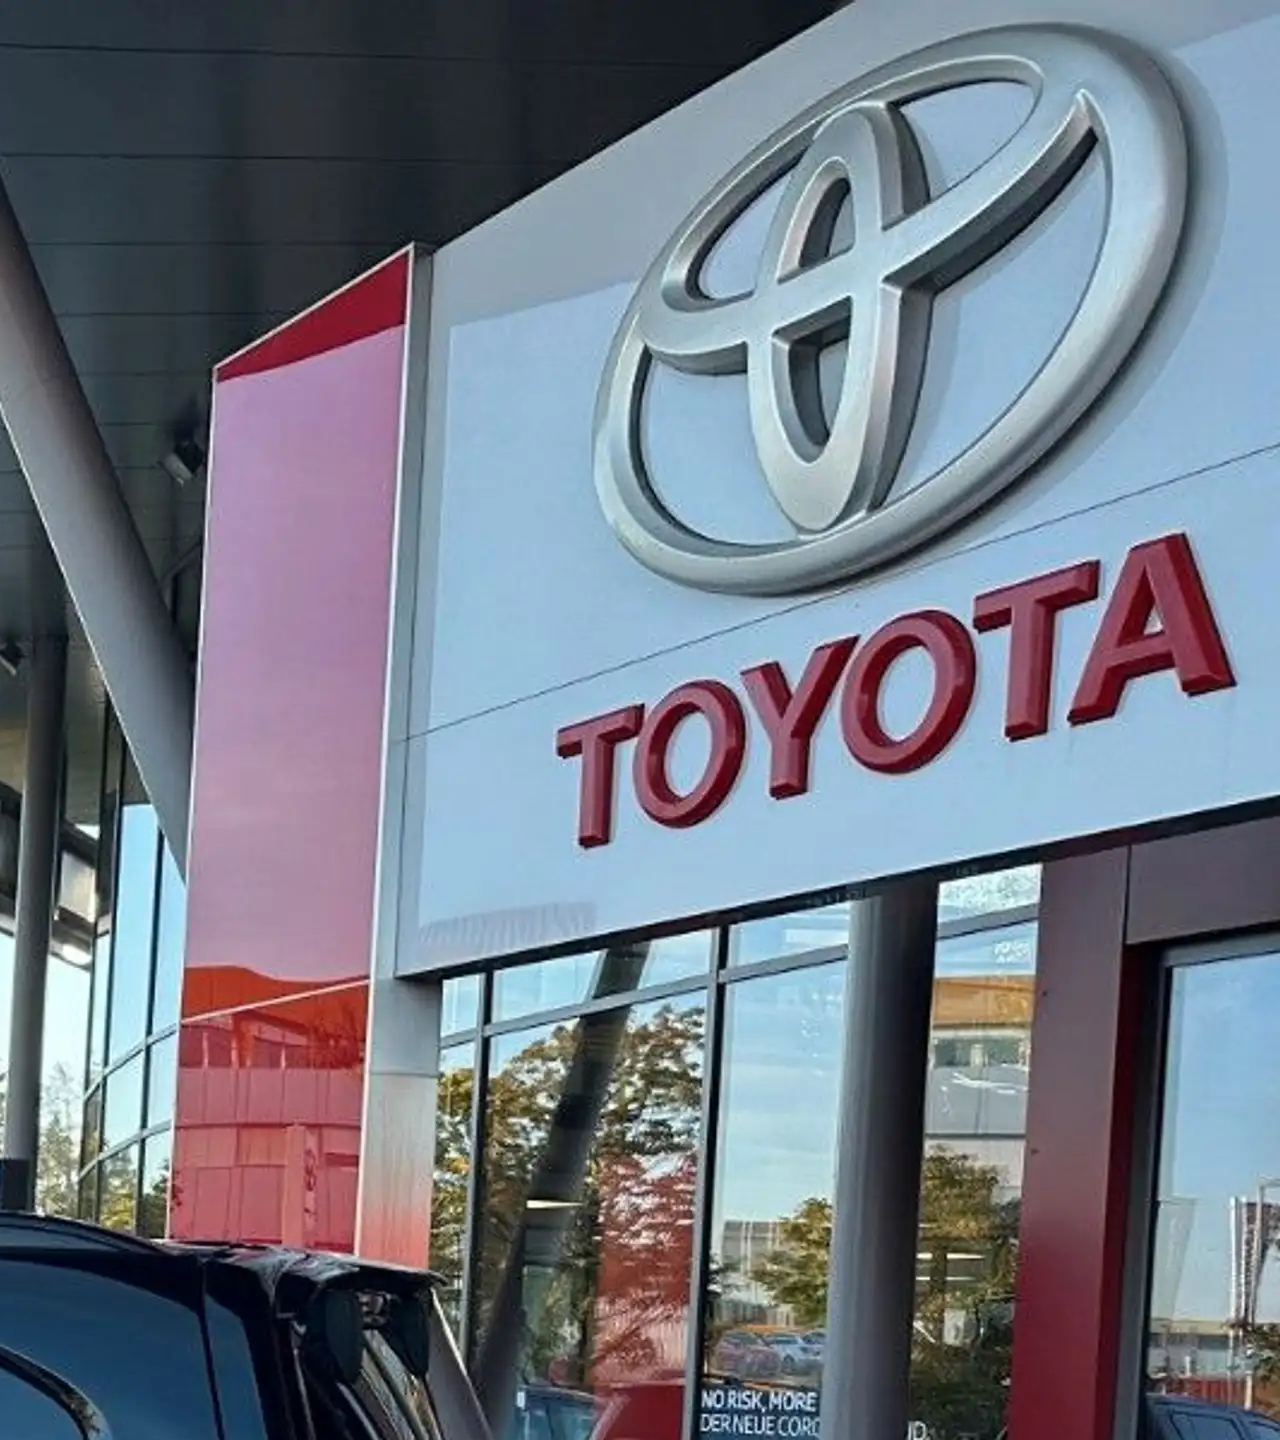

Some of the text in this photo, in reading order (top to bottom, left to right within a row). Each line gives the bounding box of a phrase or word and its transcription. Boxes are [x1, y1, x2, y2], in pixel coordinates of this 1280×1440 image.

[556, 532, 1237, 848] TOYOTA
[701, 1389, 818, 1413] NO RISK, MORE
[700, 1413, 731, 1433] DER
[733, 1414, 776, 1434] NEUE
